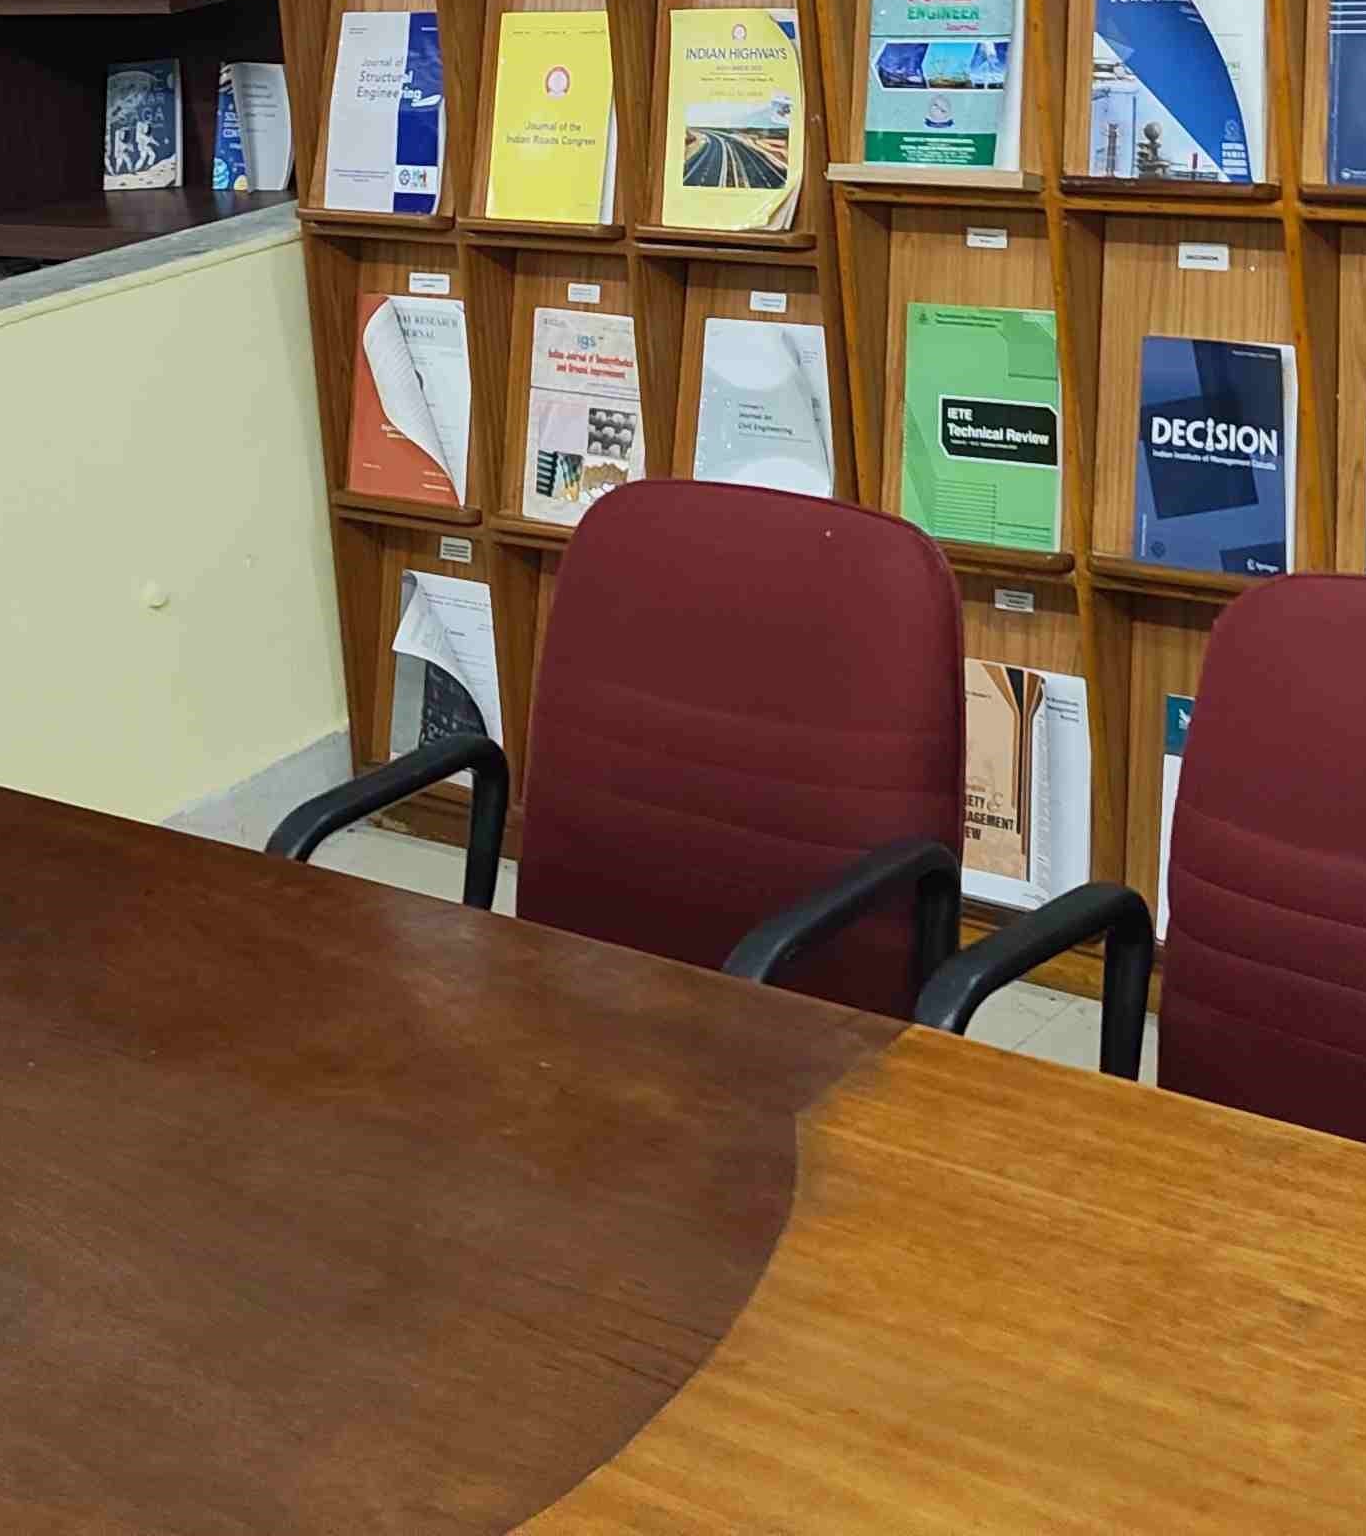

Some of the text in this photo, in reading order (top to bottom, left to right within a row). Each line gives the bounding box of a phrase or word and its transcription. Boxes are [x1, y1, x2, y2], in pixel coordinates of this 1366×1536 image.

[907, 6, 980, 21] ENGINEER
[686, 47, 788, 61] INDIAN HIGHWAYS
[361, 56, 392, 68] Journal
[356, 85, 421, 100] Engineering
[523, 122, 557, 132] Journal
[506, 134, 531, 145] Indian
[947, 408, 973, 421] IETE
[754, 424, 794, 436] Engineering
[947, 422, 1050, 446] Technical Review
[1151, 416, 1278, 457] DECISION
[966, 810, 1014, 831] AGEMENT
[965, 827, 982, 841] EW
